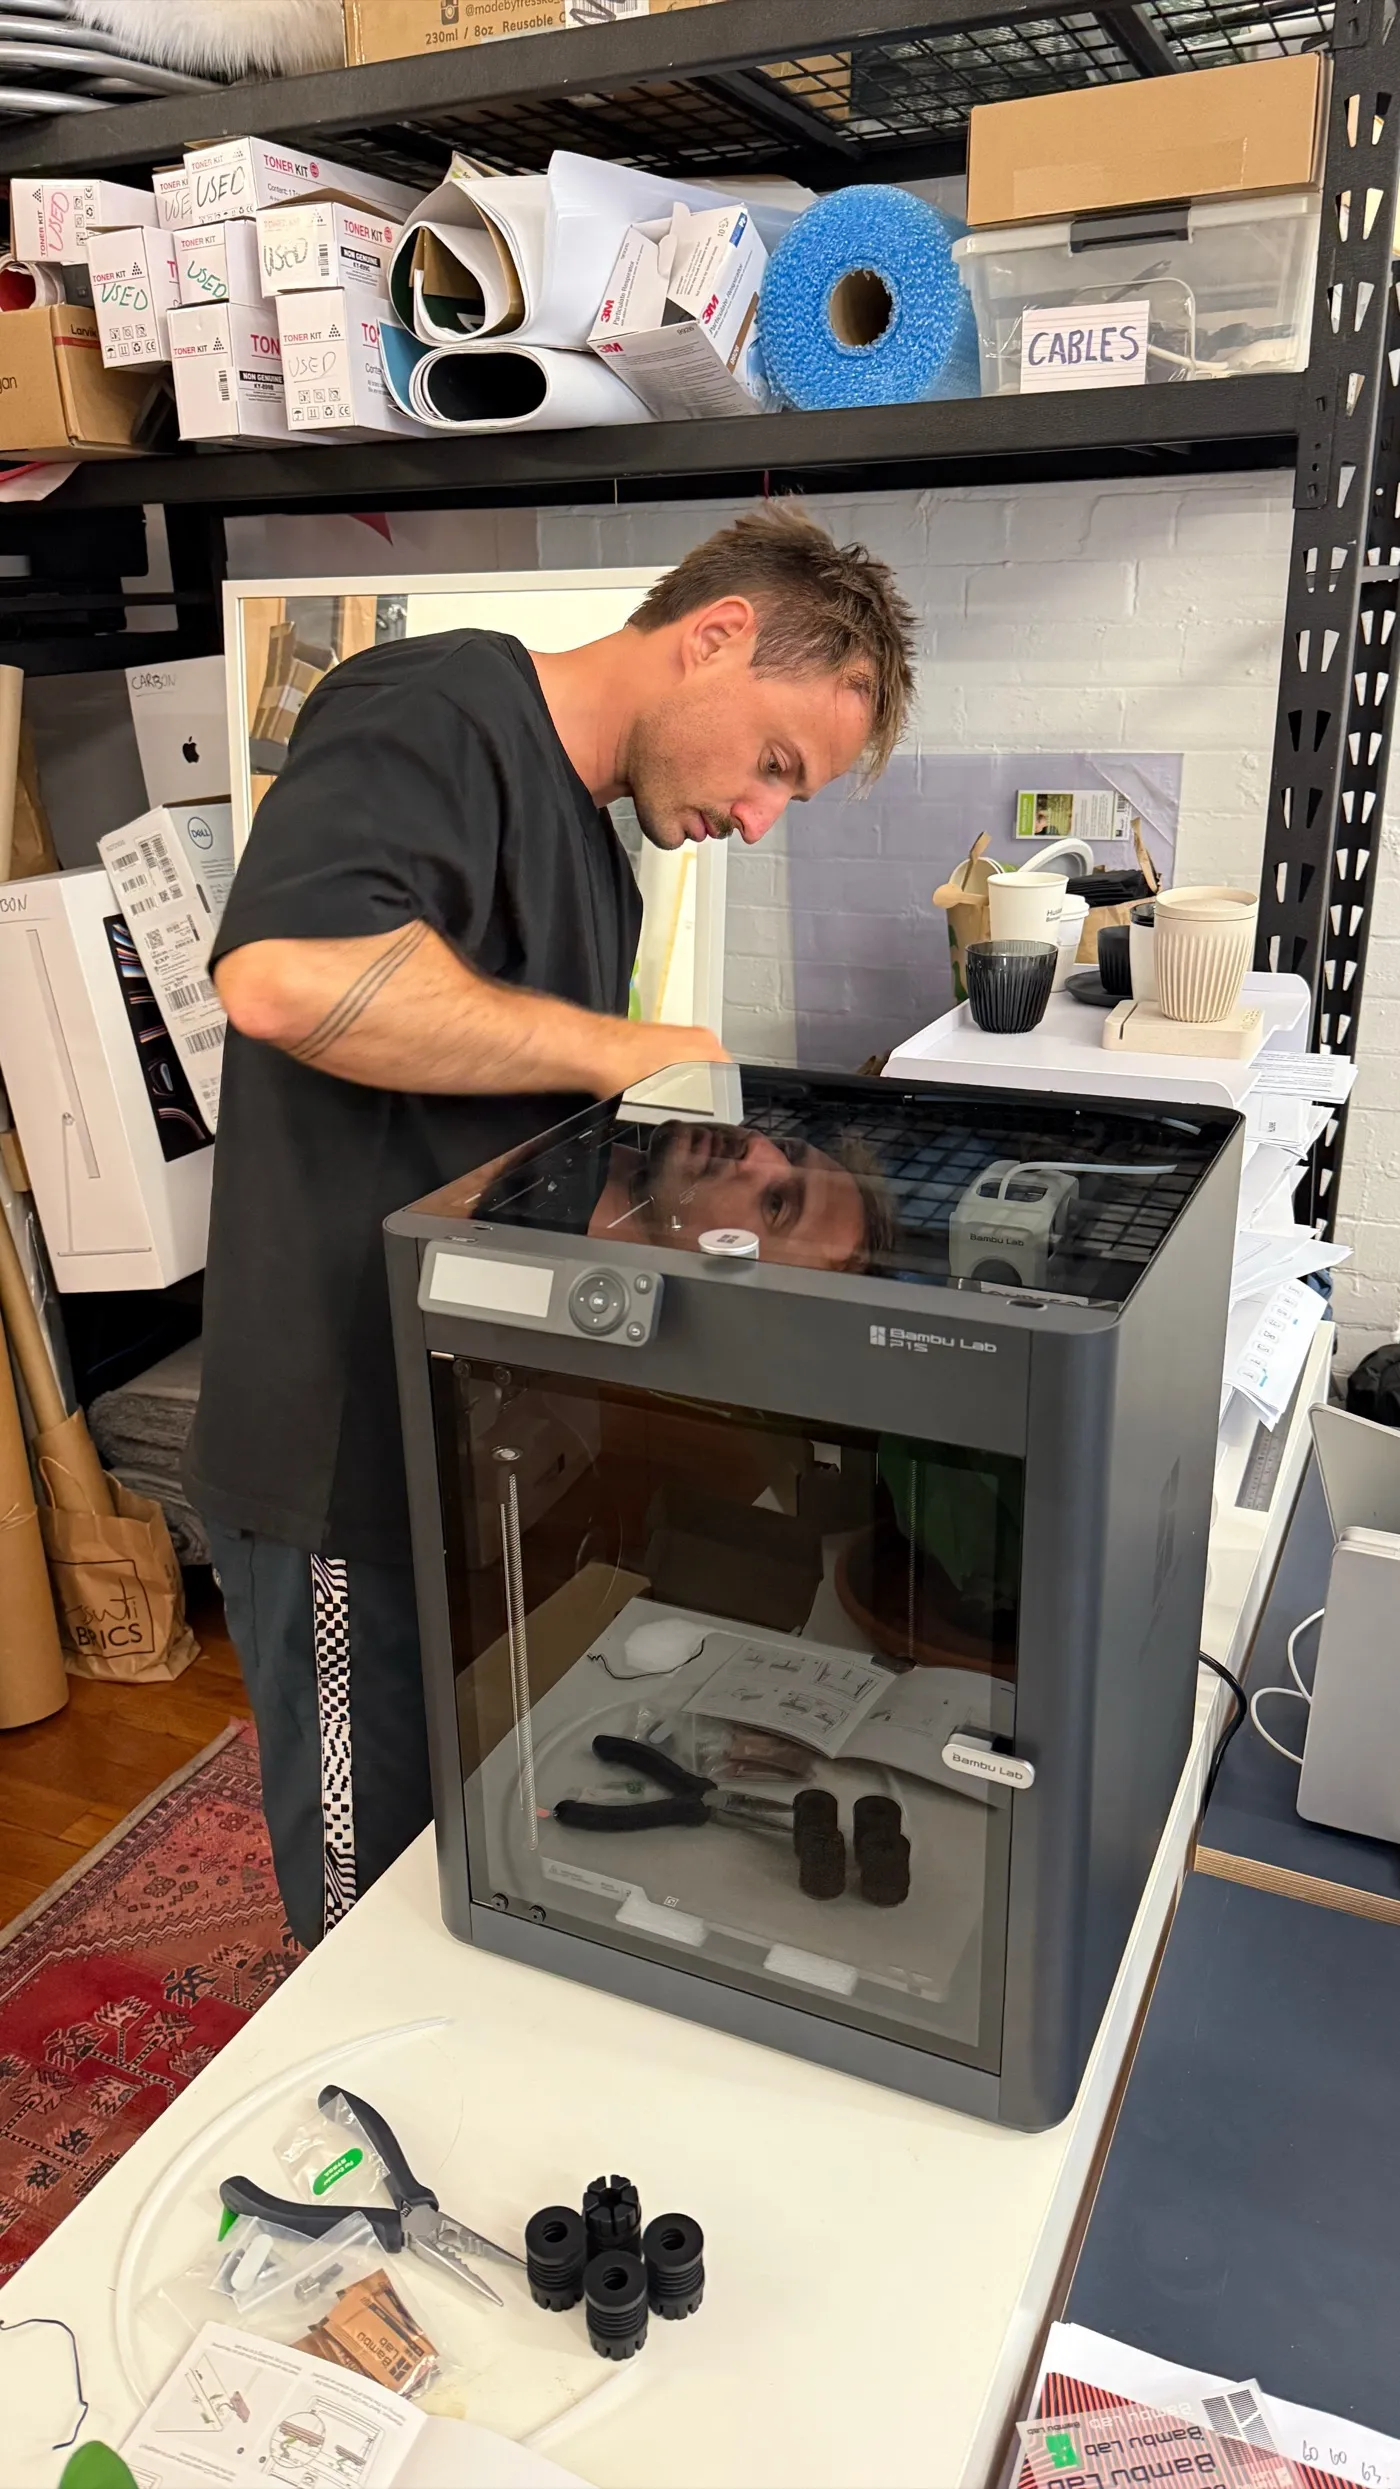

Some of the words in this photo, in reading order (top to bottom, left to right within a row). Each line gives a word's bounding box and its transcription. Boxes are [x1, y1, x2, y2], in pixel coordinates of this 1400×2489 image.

[425, 31, 458, 45] 230ml
[474, 25, 494, 37] 8oz
[502, 15, 554, 33] Reusable
[192, 156, 213, 170] TONER
[214, 155, 223, 164] KIT
[264, 154, 294, 174] TONER
[295, 164, 308, 178] KIT
[160, 180, 181, 191] TONER
[196, 166, 246, 208] USED
[48, 192, 69, 252] USED
[344, 219, 370, 237] TONER
[371, 230, 383, 242] KIT
[181, 237, 204, 248] TONER
[205, 235, 216, 244] KIT
[263, 237, 308, 277] USED
[93, 273, 115, 283] TONER
[116, 270, 126, 279] KIT
[187, 260, 227, 298] USED
[101, 282, 148, 311] USED
[613, 293, 626, 325] Particulate
[621, 261, 634, 292] Respirator
[709, 299, 728, 335] Particulate
[726, 264, 743, 297] Respirator
[601, 299, 614, 323] 3M
[702, 294, 719, 324] 3M
[283, 333, 309, 342] TONER
[310, 331, 322, 340] KIT
[597, 342, 624, 353] 3M
[1028, 326, 1139, 367] CABLES
[173, 346, 196, 355] TONER
[197, 344, 208, 352] KIT
[287, 351, 336, 379] USED
[257, 374, 283, 384] GENUINE
[132, 673, 176, 689] CARBON
[191, 829, 211, 838] DELL
[970, 1233, 1003, 1244] Bambu
[1007, 1237, 1024, 1247] Lab
[890, 1327, 955, 1348] Bambu
[960, 1338, 997, 1353] Lab
[890, 1338, 928, 1353] P1S
[76, 1623, 142, 1650] BRICS
[952, 1752, 996, 1772] Bambu
[1000, 1767, 1023, 1780] Lab
[357, 2332, 393, 2368] Bambu
[379, 2337, 400, 2359] Lab
[1088, 2415, 1122, 2430] Lab
[1129, 2402, 1193, 2422] Bambu
[1027, 2427, 1045, 2435] Lab
[1047, 2421, 1081, 2432] Bambu
[1129, 2426, 1204, 2449] Bambu
[1084, 2440, 1124, 2456] Lab
[1110, 2452, 1217, 2486] Bambu
